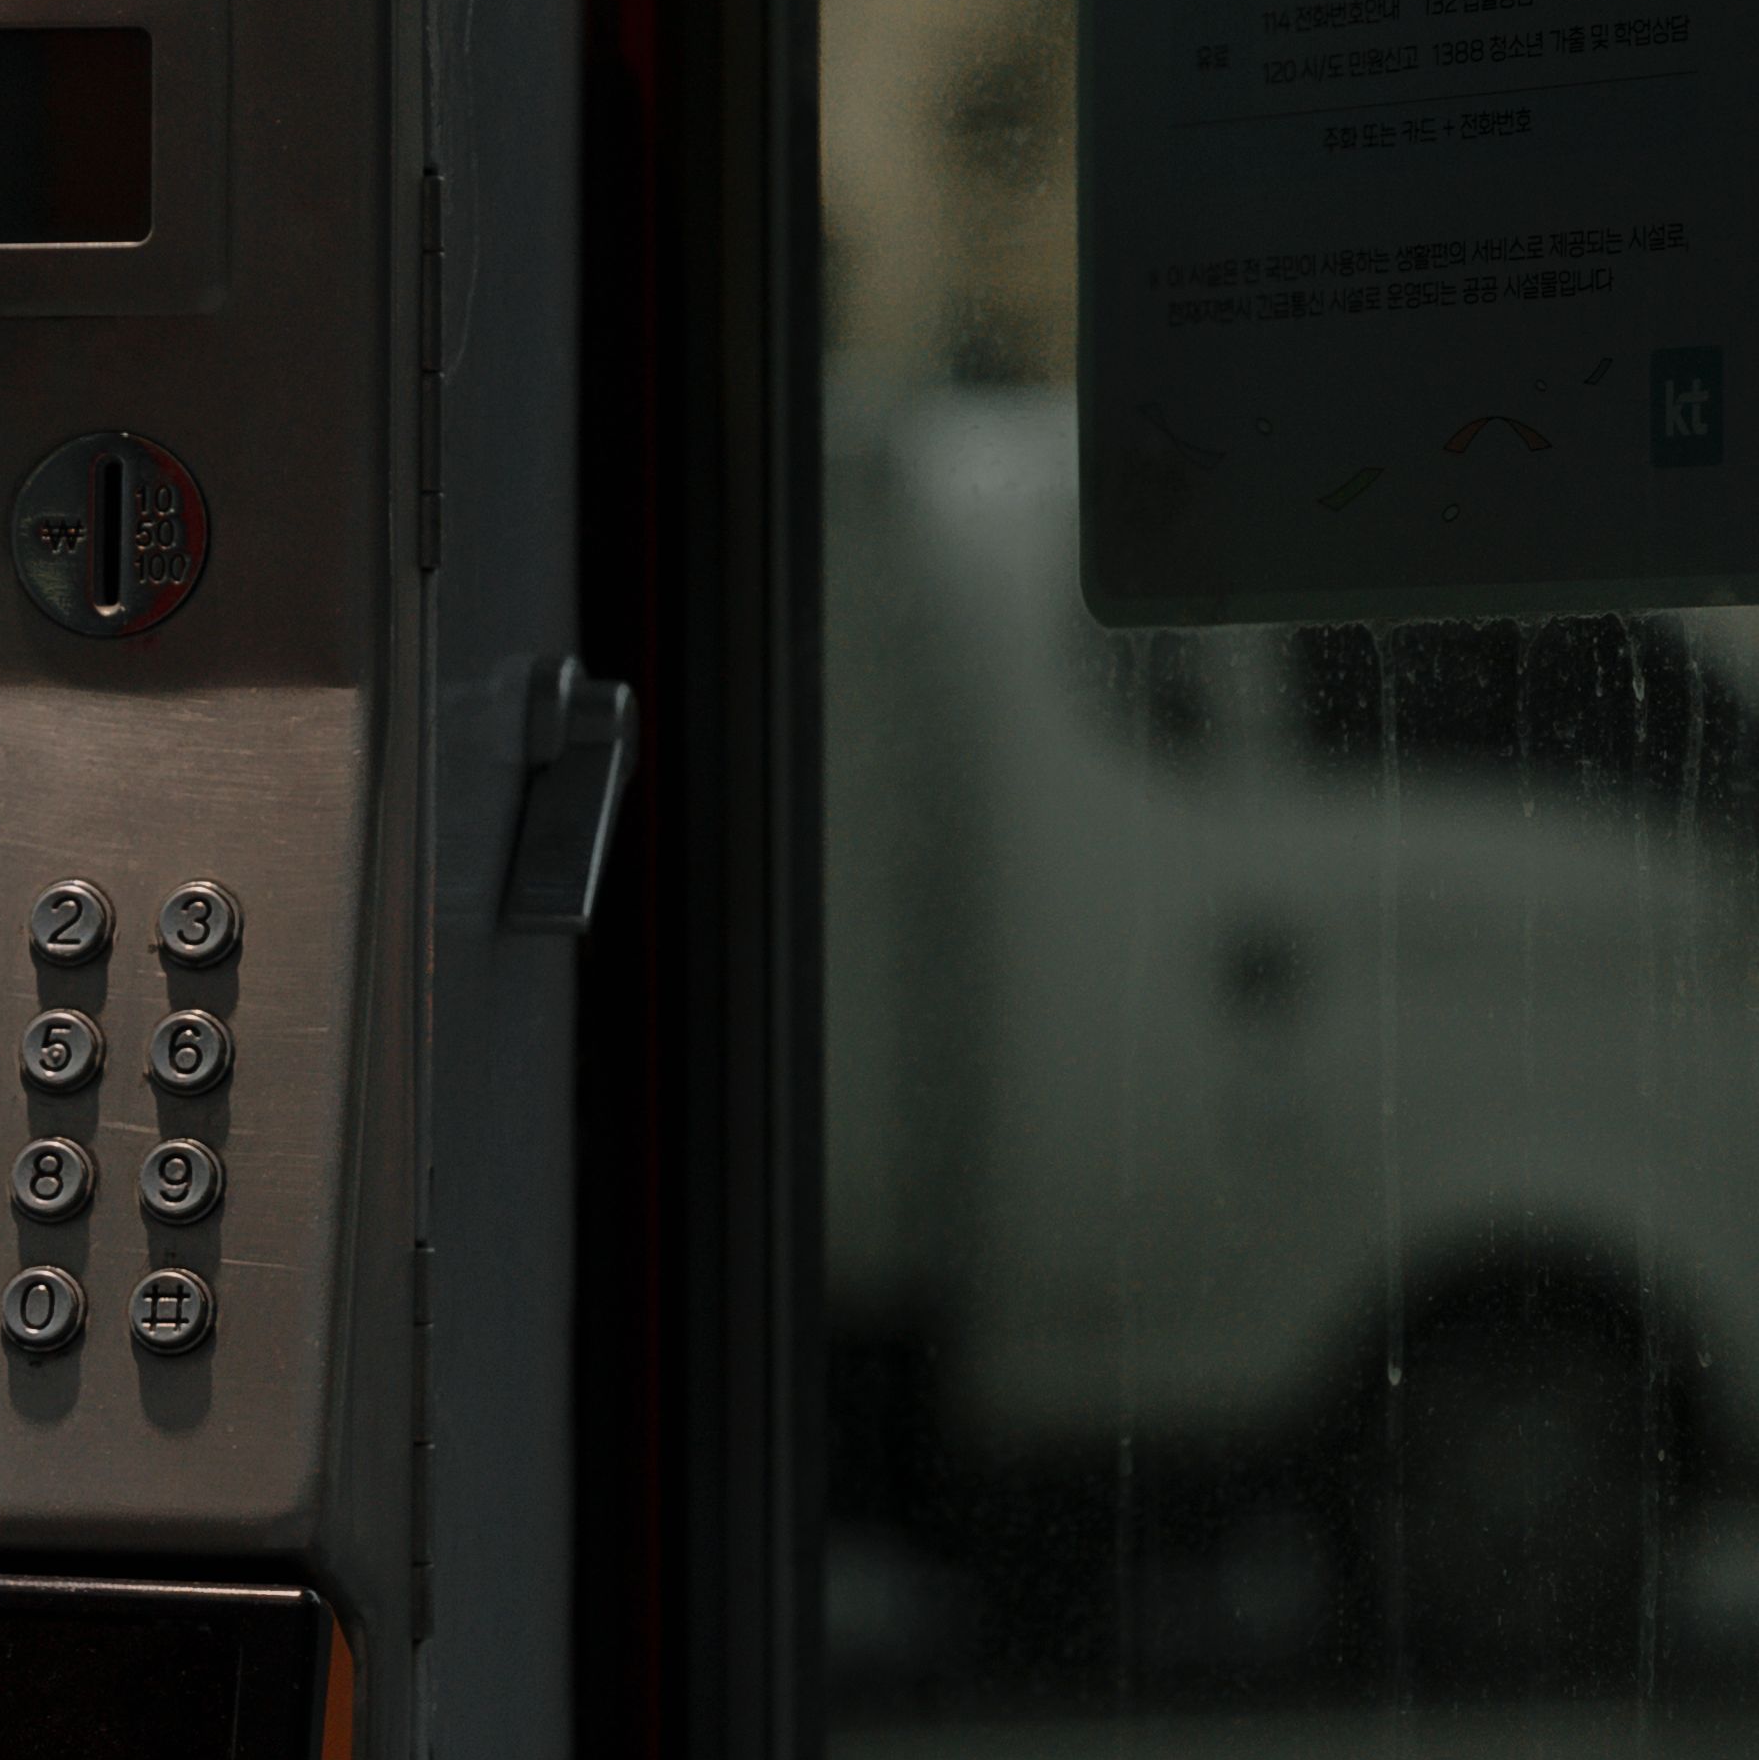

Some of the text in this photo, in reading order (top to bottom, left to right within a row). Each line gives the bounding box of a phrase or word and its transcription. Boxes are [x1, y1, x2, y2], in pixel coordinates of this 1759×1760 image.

[1262, 10, 1292, 35] 114
[1262, 15, 1690, 86] 120 시/도 민원신고 1388 청소년 가출 및 학업상담
[1361, 107, 1533, 148] 또는 카드 전화번호
[1265, 251, 1317, 282] 국민이
[1321, 246, 1390, 278] 사용하는
[1395, 241, 1467, 274] 생활편의
[1471, 234, 1544, 268] 서비스로
[1548, 228, 1623, 259] 제공되는
[1329, 284, 1381, 315] 시설로
[1387, 280, 1458, 310] 운영되는
[1462, 275, 1498, 304] 공공
[1503, 268, 1614, 301] 시설물입니다
[1664, 377, 1710, 437] kt
[136, 484, 175, 516] 10
[136, 519, 176, 550] 50
[135, 552, 188, 585] 100
[47, 897, 83, 946] 2
[177, 897, 212, 946] 3
[39, 1024, 72, 1073] 5
[168, 1025, 203, 1075] 6
[30, 1152, 64, 1201] 8
[158, 1153, 193, 1202] 9
[19, 1282, 54, 1331] 0
